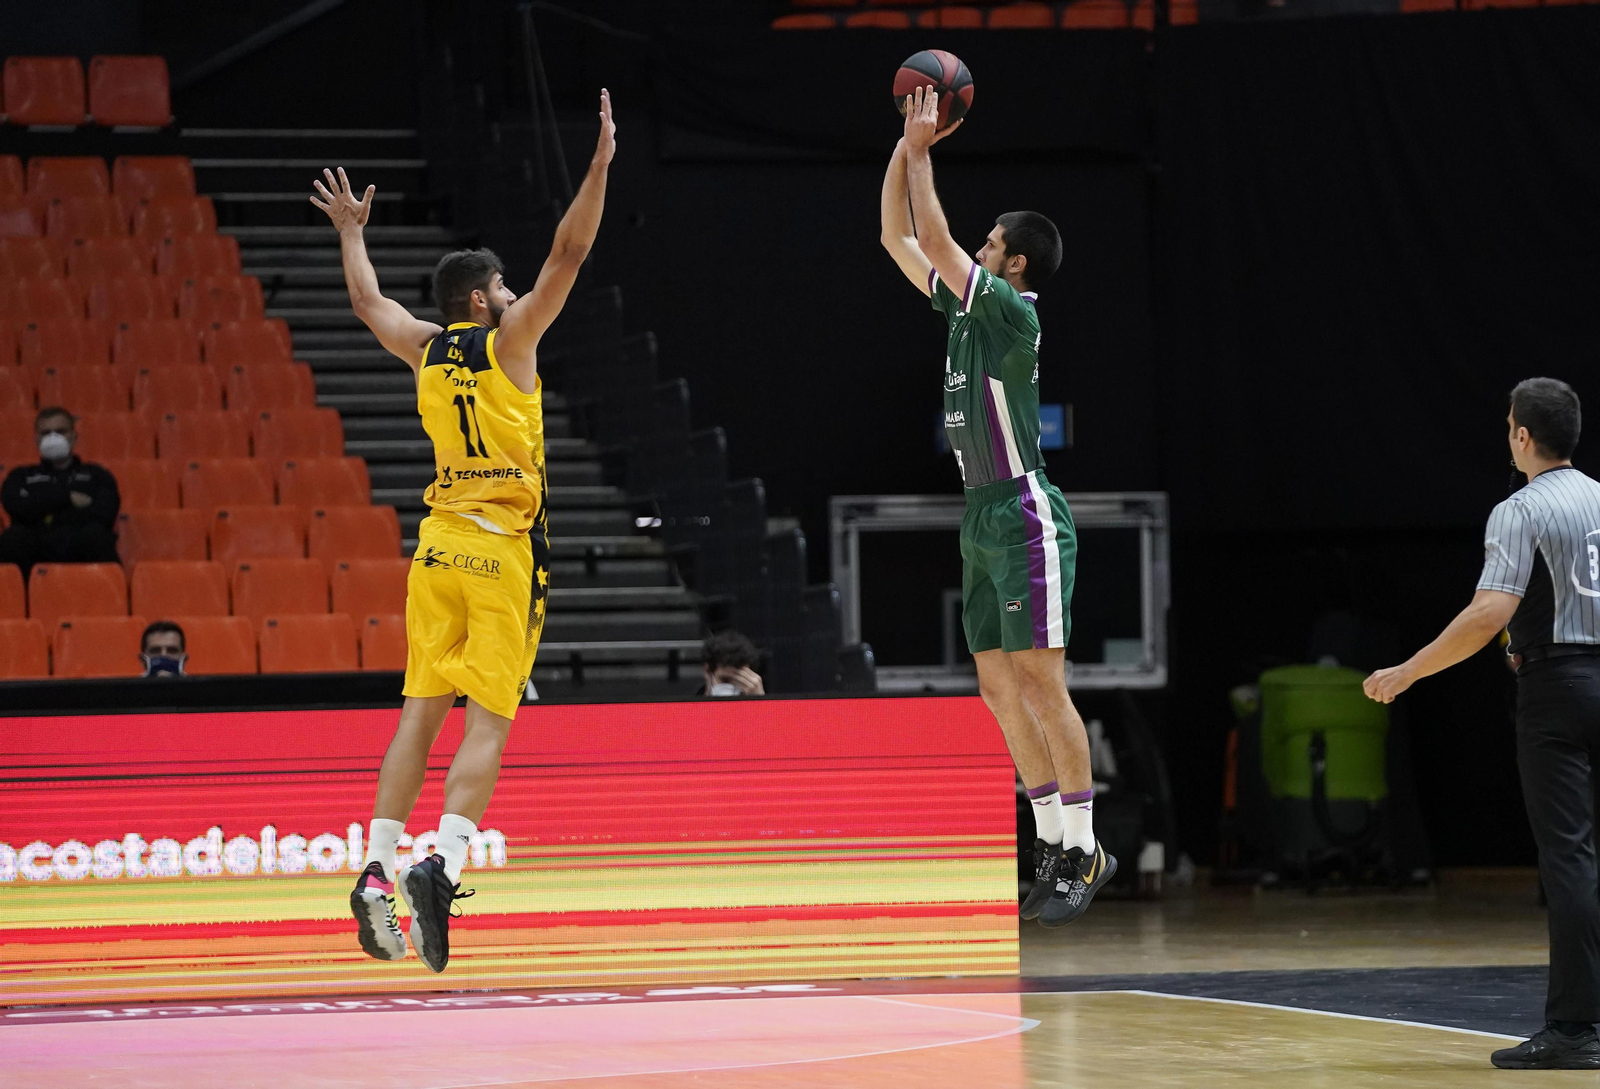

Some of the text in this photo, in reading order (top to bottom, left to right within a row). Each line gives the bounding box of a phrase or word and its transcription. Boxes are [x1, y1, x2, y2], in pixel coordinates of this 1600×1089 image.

[453, 395, 490, 458] 11
[455, 468, 523, 480] TENERIFE
[453, 553, 501, 574] CICAR
[1587, 544, 1599, 581] 3
